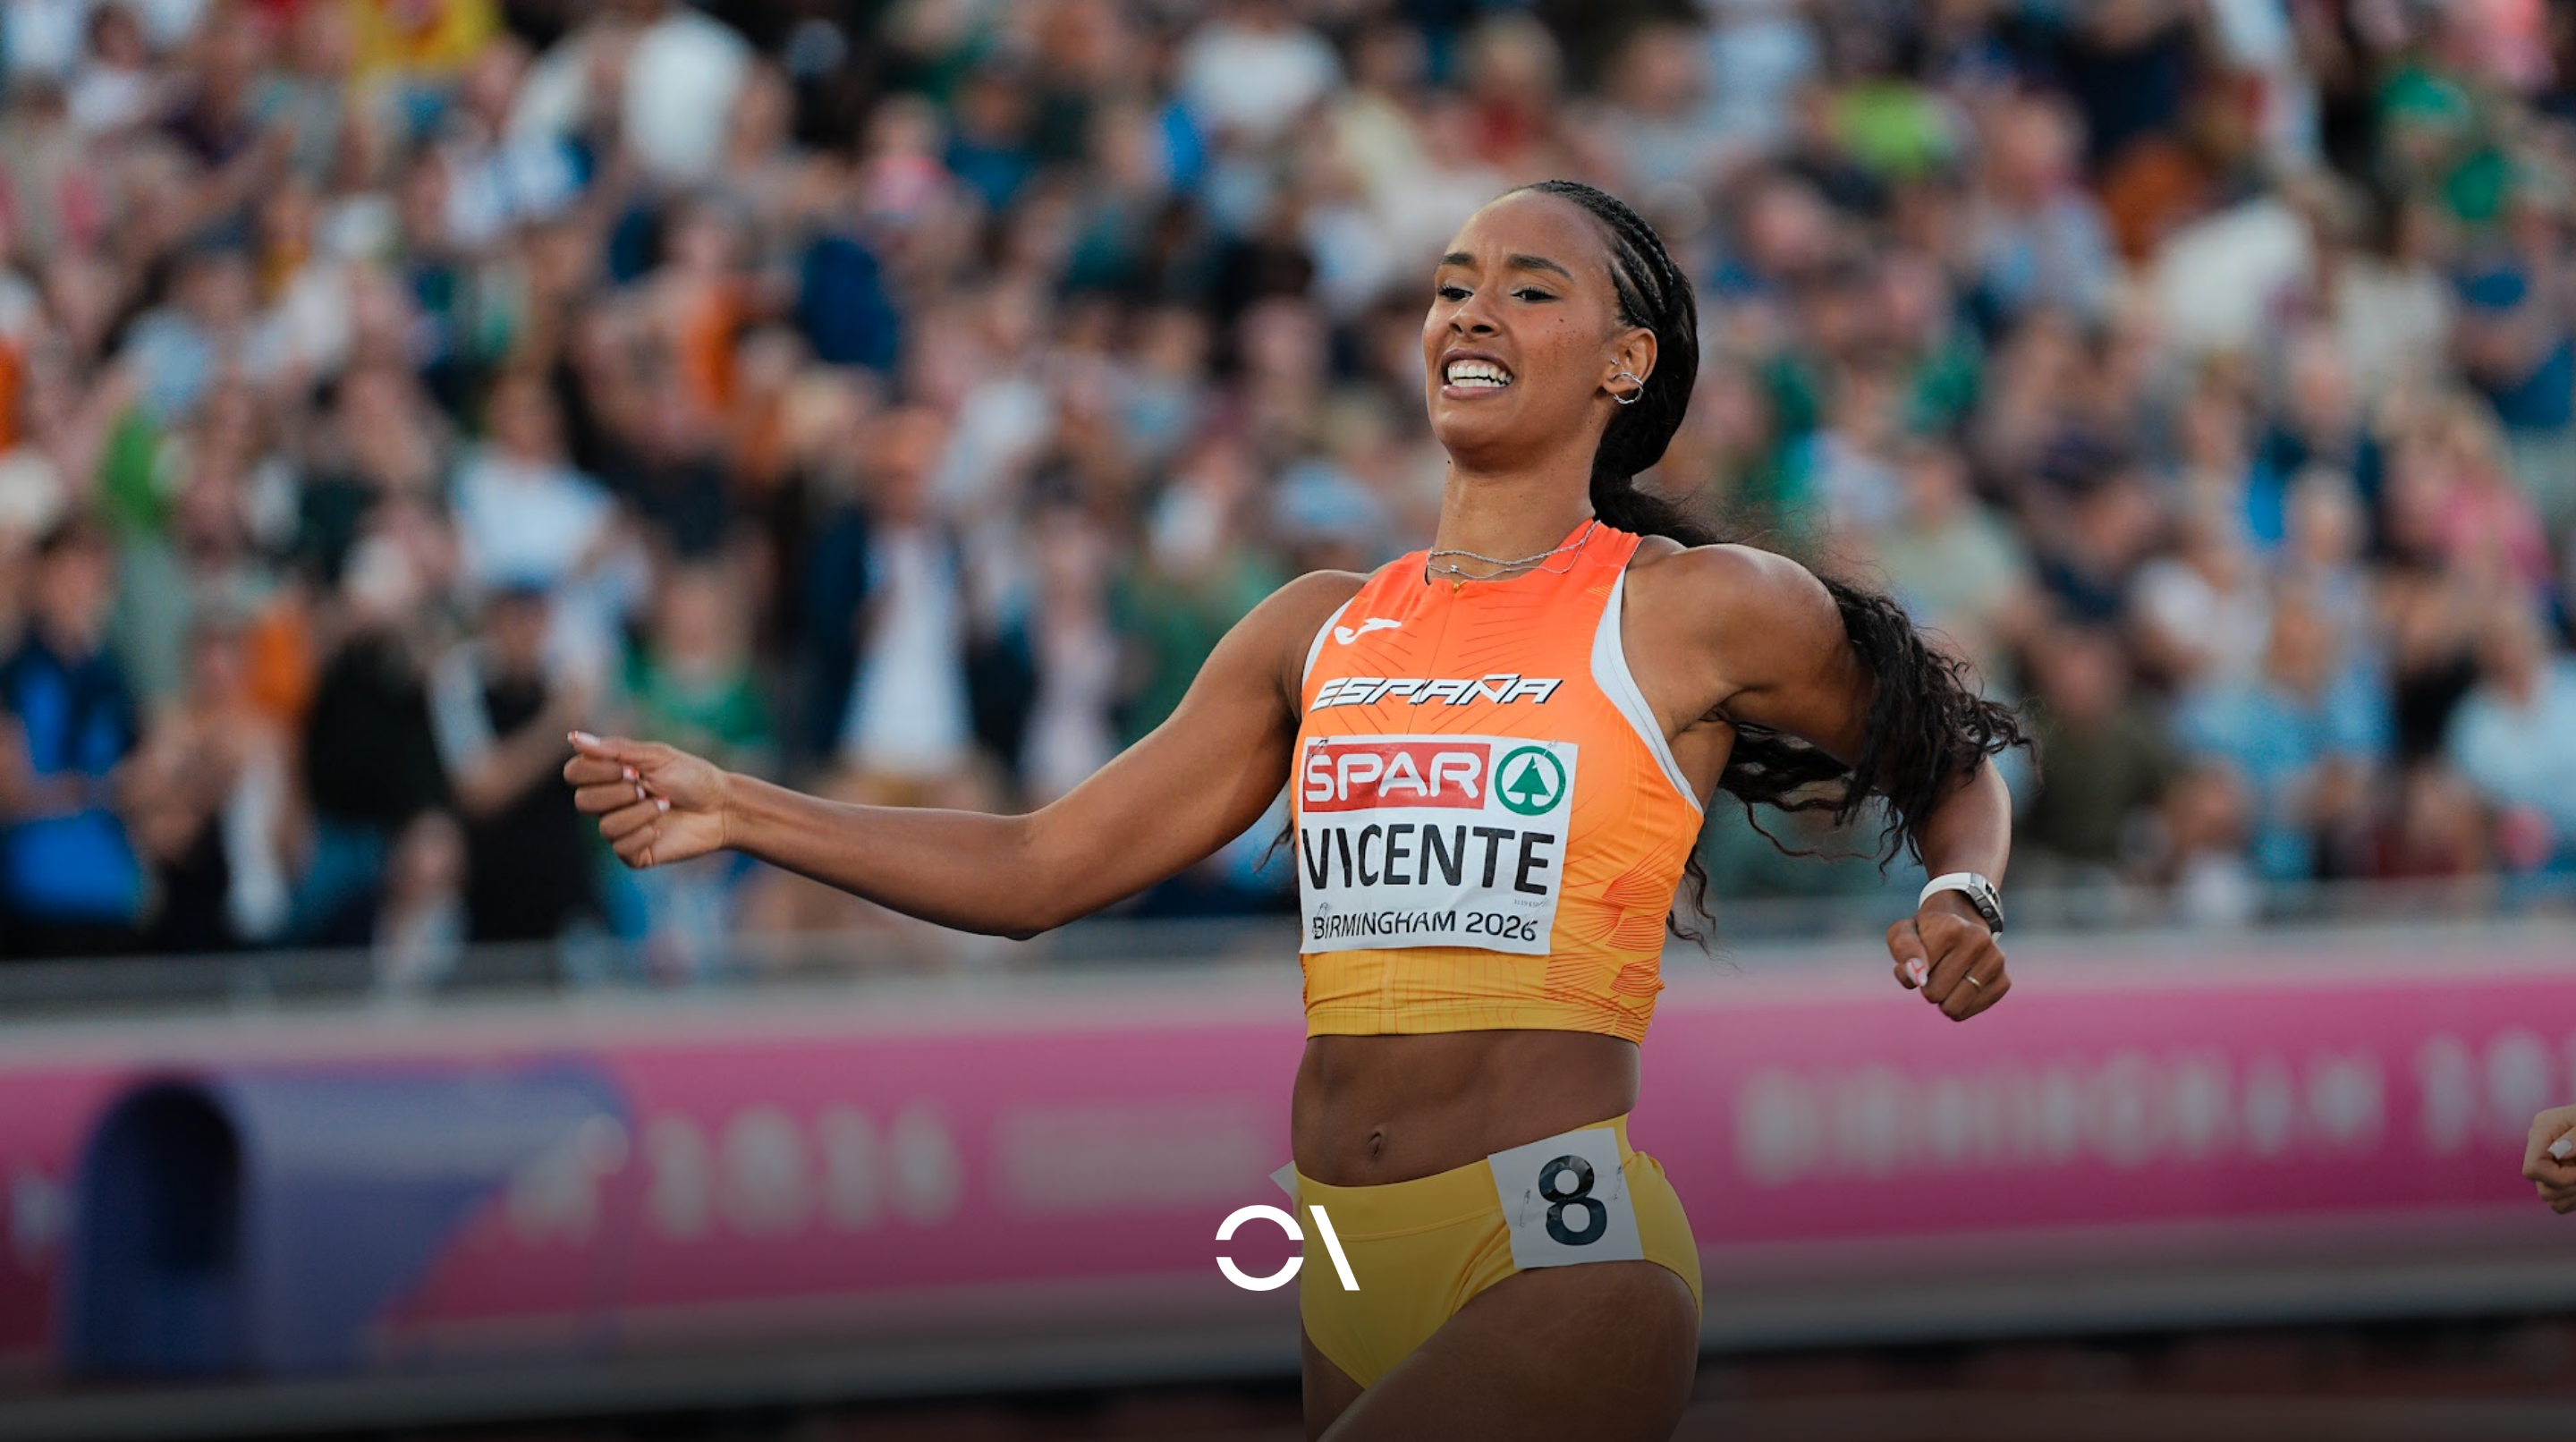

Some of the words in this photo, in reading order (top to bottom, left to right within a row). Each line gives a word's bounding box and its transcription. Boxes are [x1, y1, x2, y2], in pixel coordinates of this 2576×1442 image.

[1309, 674, 1563, 714] ESPAÑA
[1305, 751, 1482, 802] SPAR
[1301, 823, 1555, 895] VICENTE
[1313, 911, 1456, 940] BIRMINGHAM
[1465, 912, 1539, 941] 2026
[1538, 1155, 1608, 1247] 8
